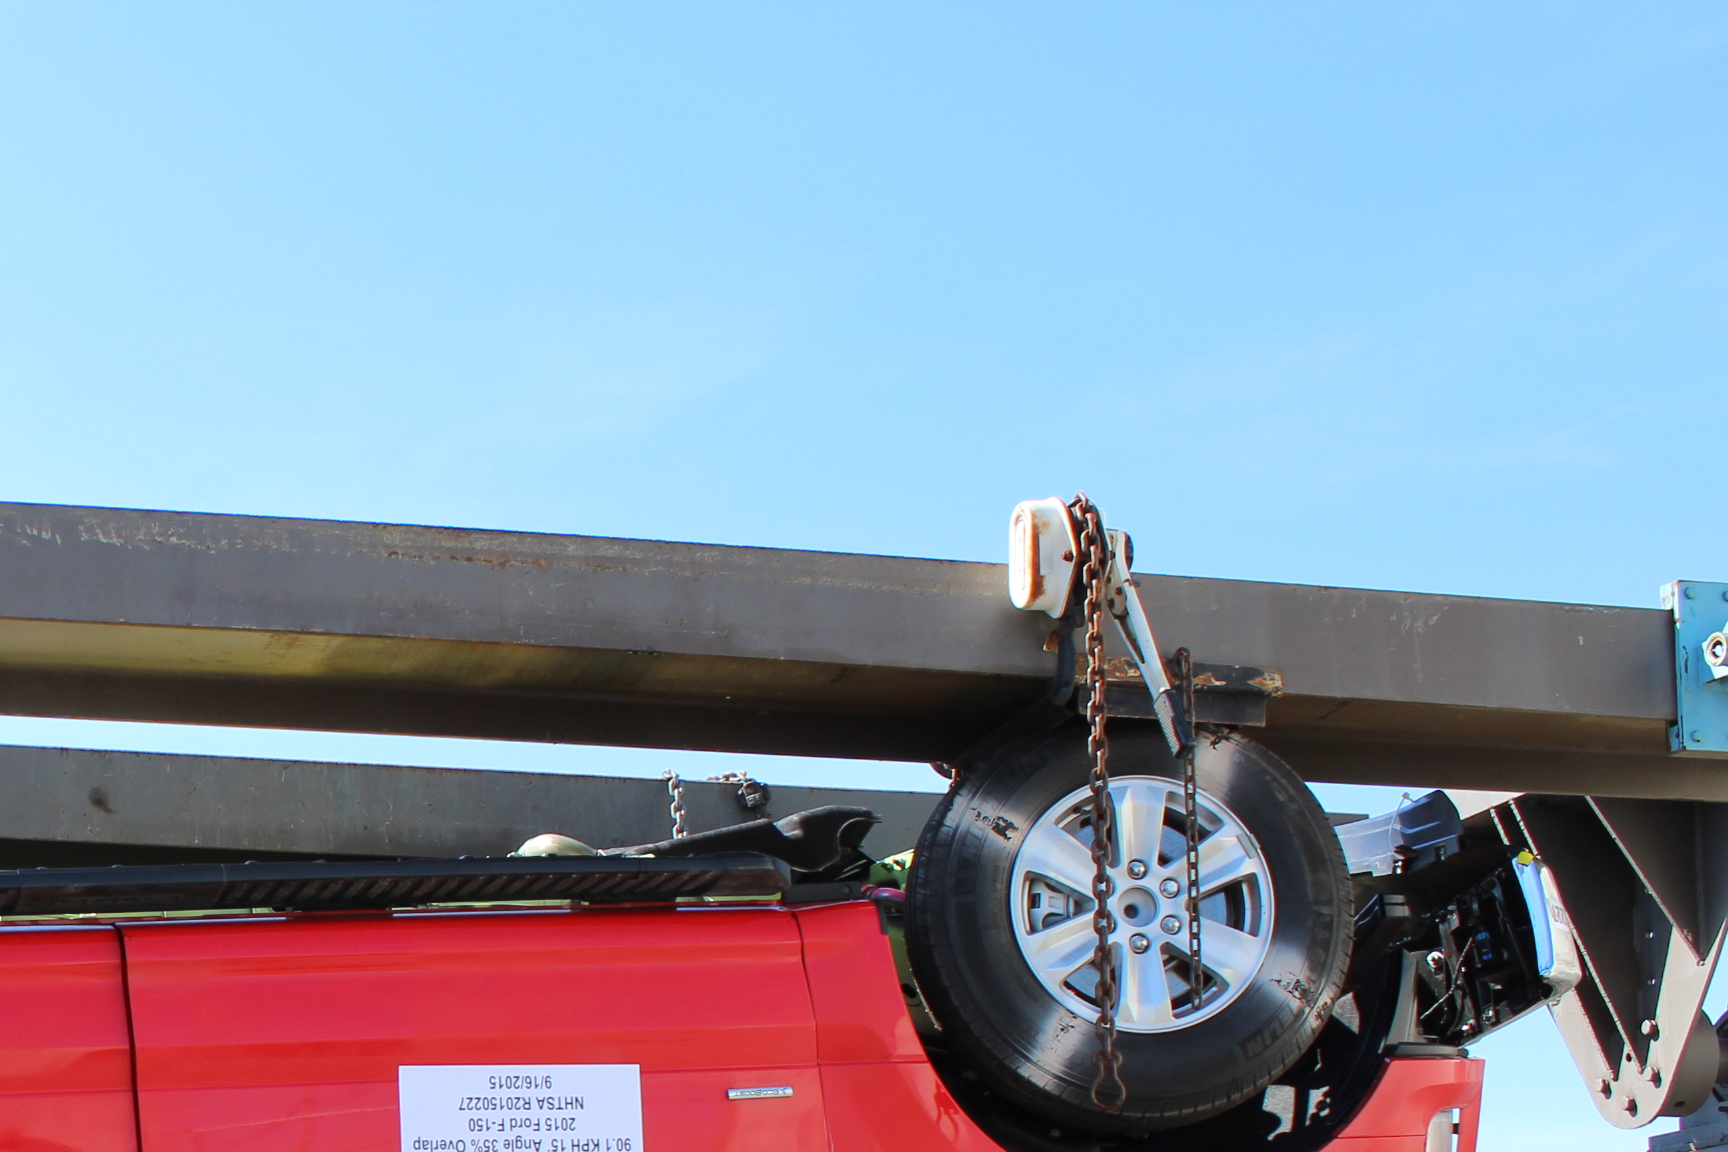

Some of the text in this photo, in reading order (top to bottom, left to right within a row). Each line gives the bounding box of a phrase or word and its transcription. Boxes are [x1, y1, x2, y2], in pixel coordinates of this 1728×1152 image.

[488, 1075, 553, 1090] 9/16/2015
[458, 1096, 584, 1111] NHTSA R20150227
[468, 1117, 576, 1133] 2015 Ford F-150
[502, 1134, 543, 1152] Angle
[570, 1138, 600, 1152] KPH
[605, 1137, 632, 1152] 90.1
